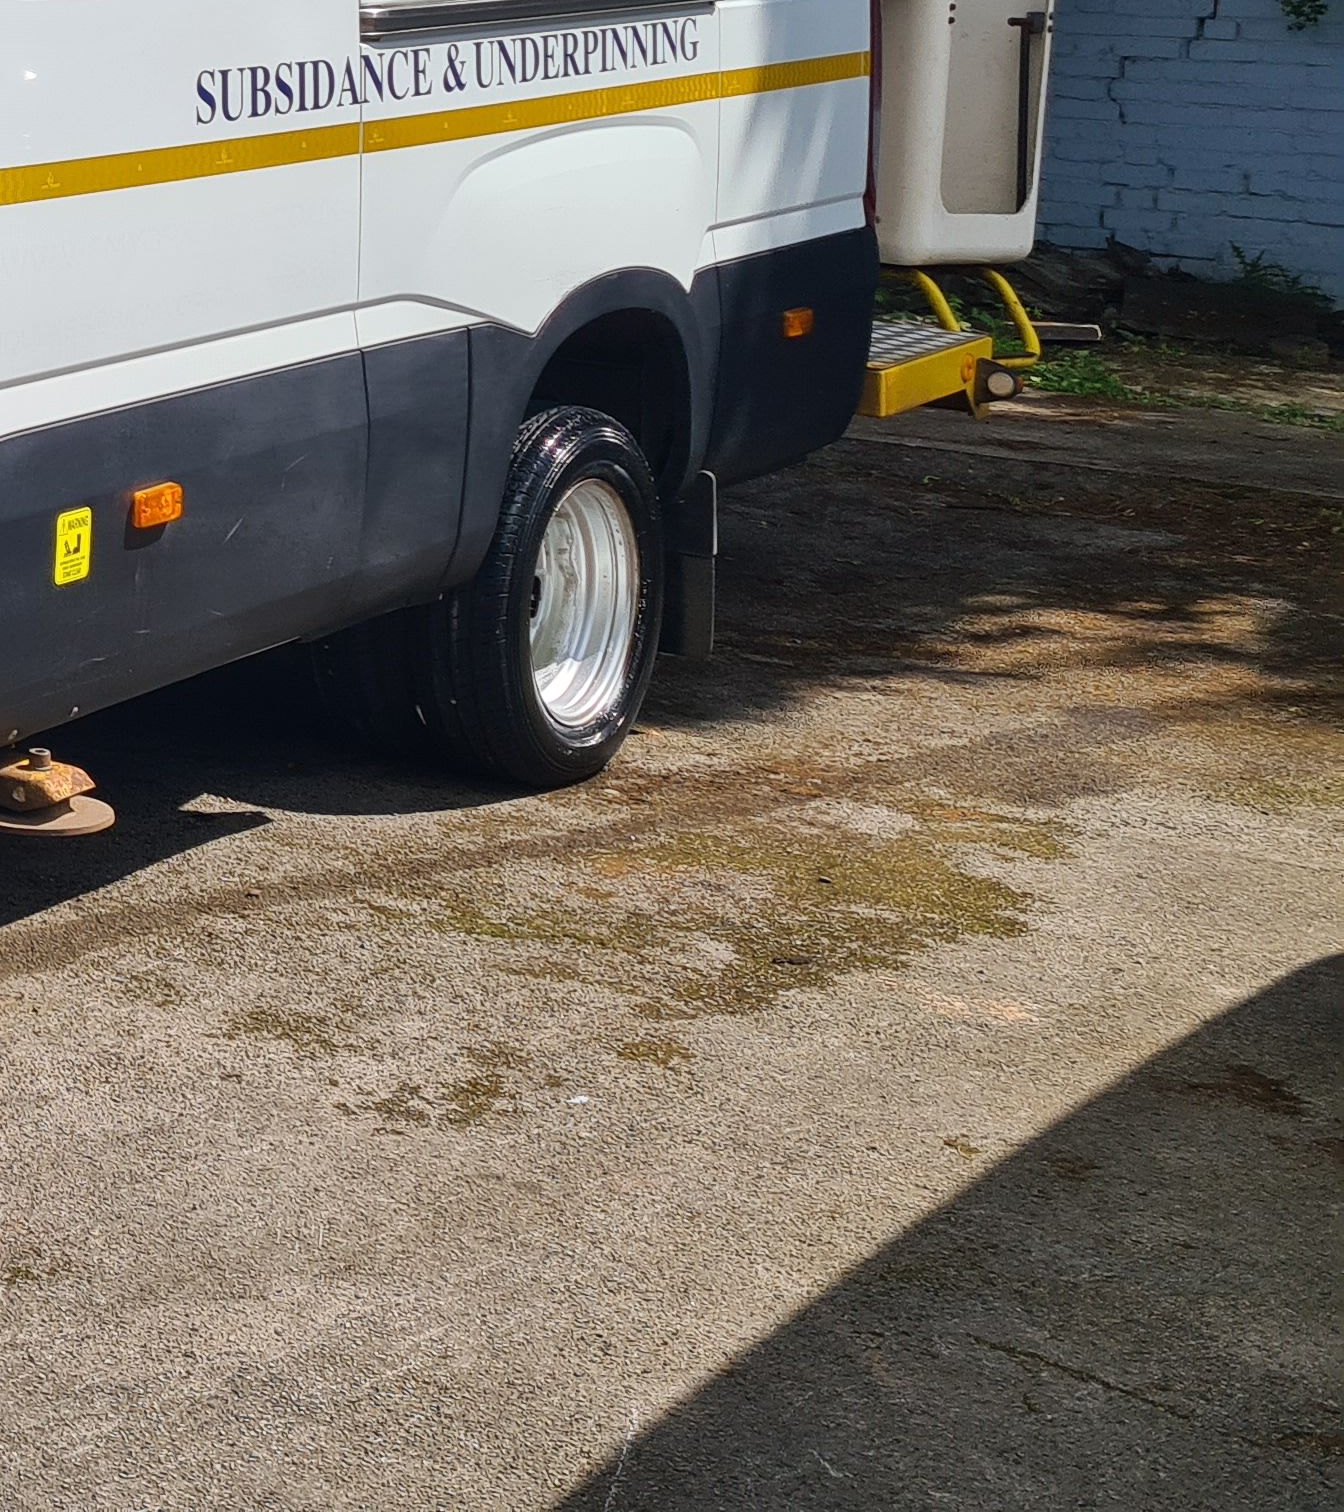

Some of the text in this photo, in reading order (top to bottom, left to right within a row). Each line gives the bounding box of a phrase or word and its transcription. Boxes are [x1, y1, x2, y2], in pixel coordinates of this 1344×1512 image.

[195, 18, 699, 125] SUBSIDANCE & UNDERPINNING
